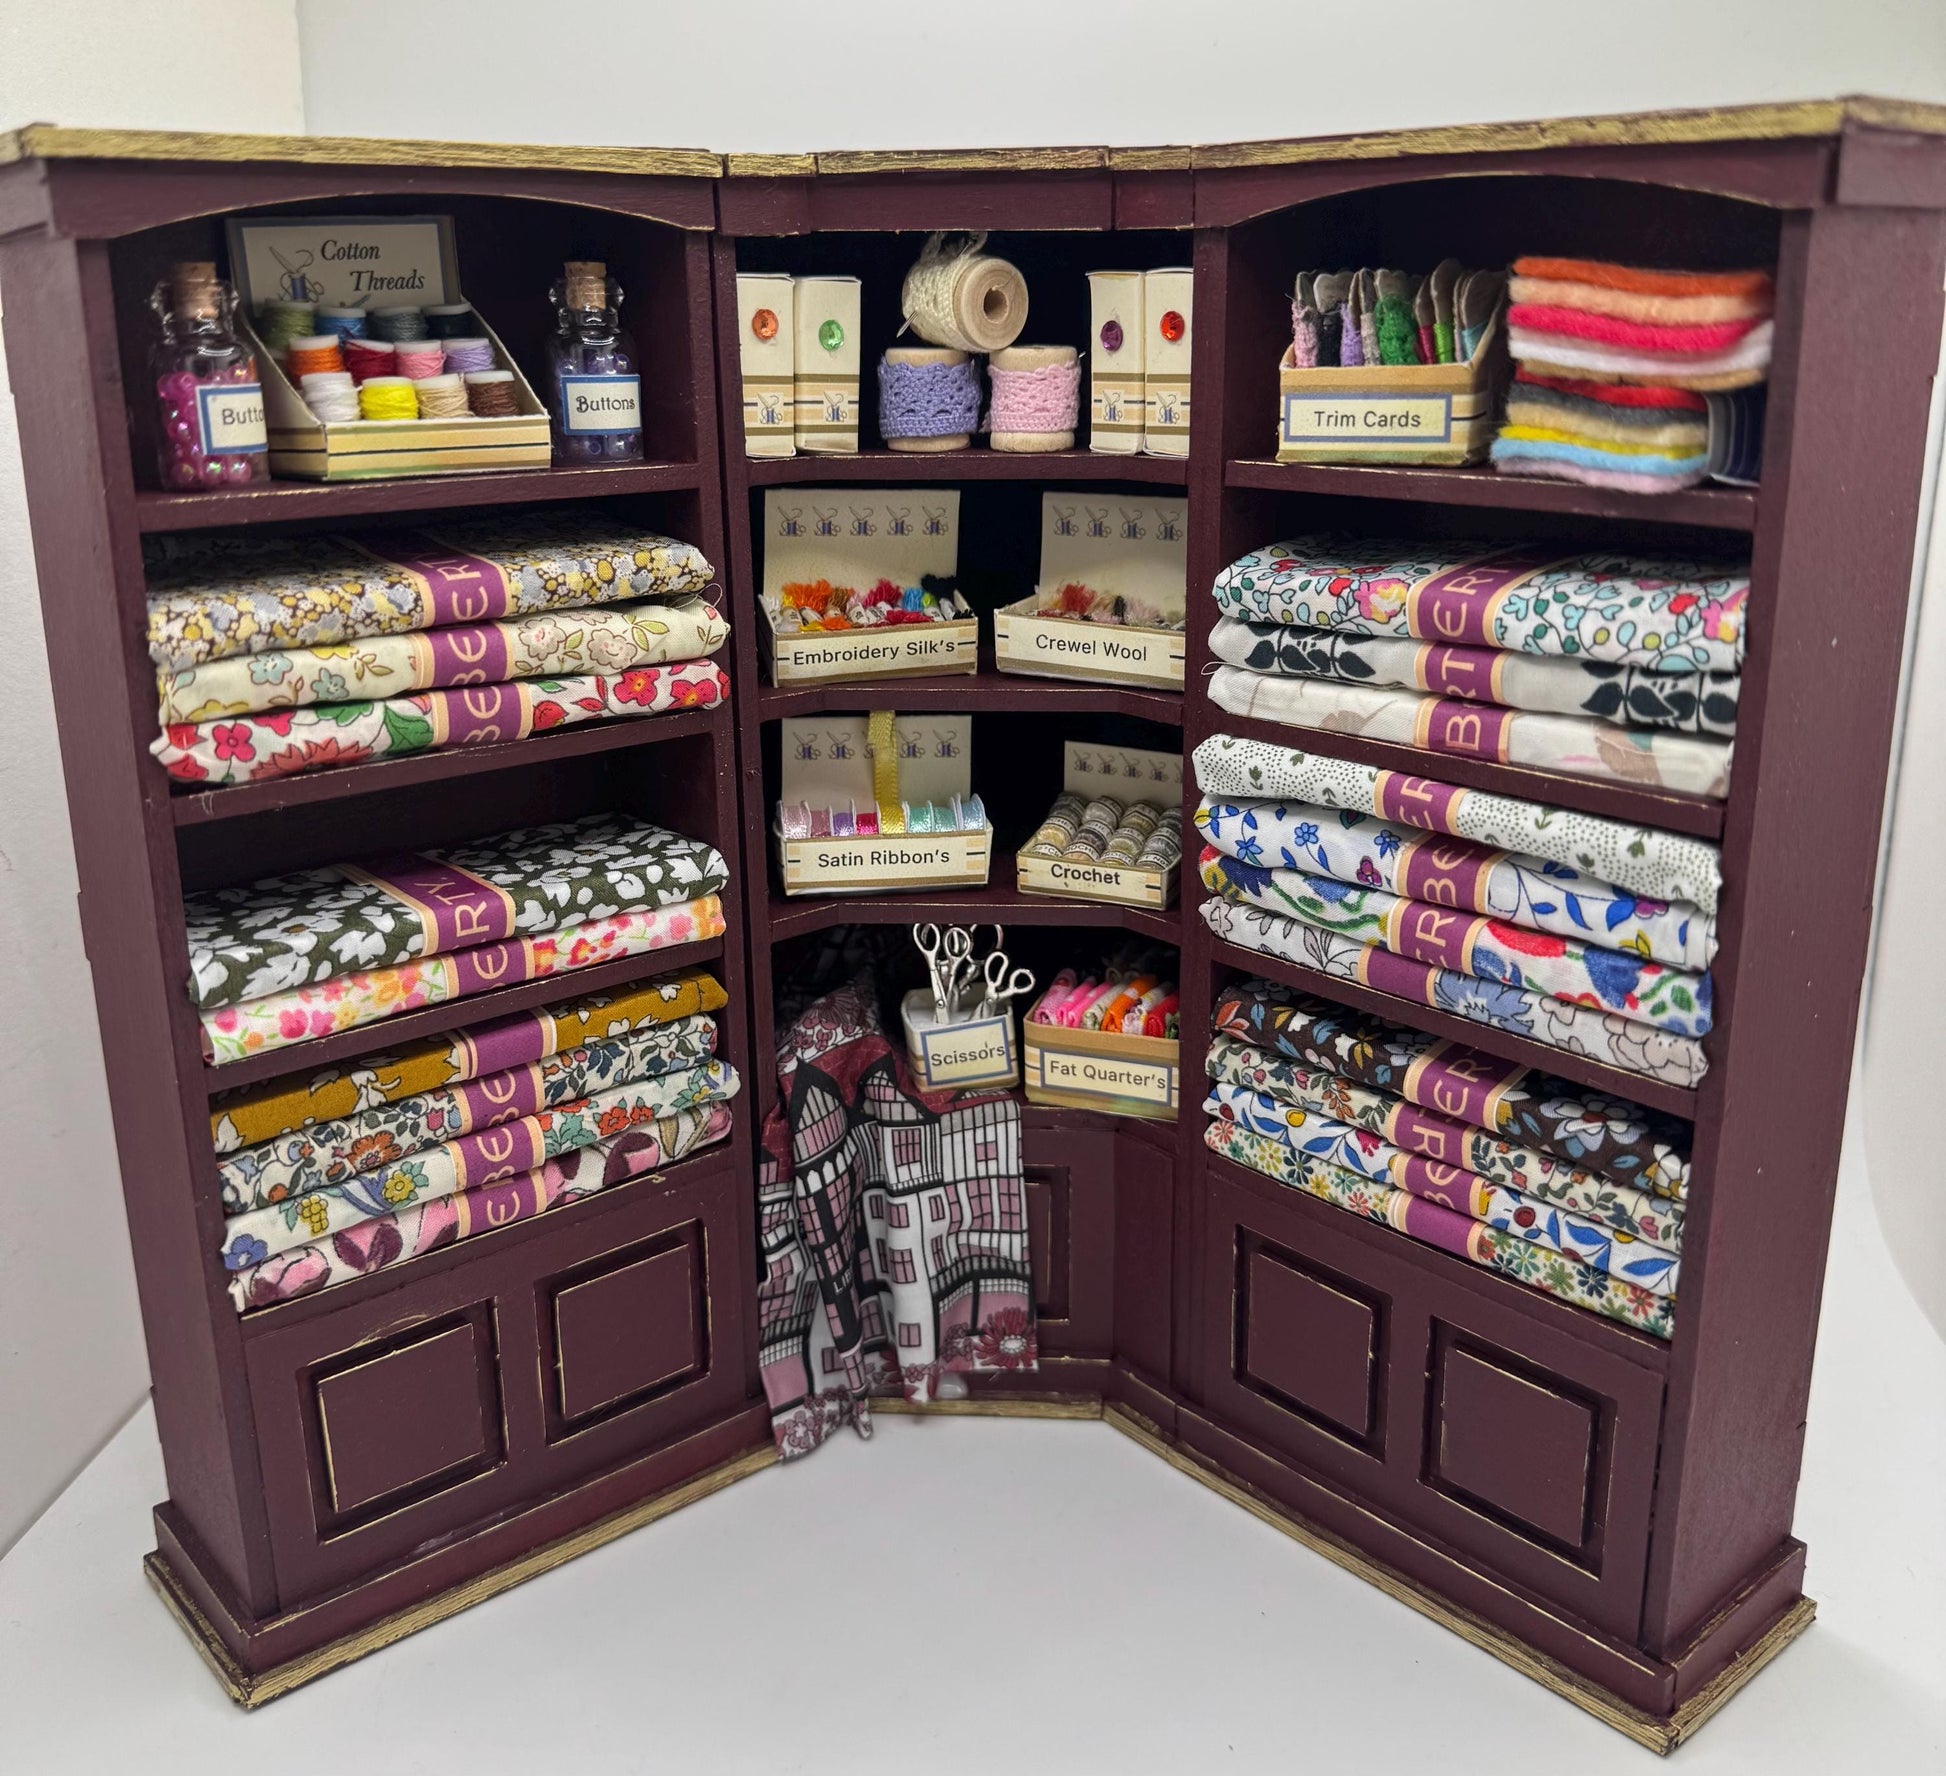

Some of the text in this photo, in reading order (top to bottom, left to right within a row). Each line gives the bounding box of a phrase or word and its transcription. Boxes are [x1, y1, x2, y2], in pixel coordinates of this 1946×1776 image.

[321, 239, 380, 261] Cotton
[349, 269, 425, 291] Threads
[576, 395, 635, 413] Buttons
[1314, 411, 1421, 427] Trim Cards
[794, 640, 955, 665] Embroidery Silk's
[1036, 634, 1147, 661] Crewel Wool
[818, 849, 950, 867] Satin Ribbon's
[1051, 863, 1121, 885] Crochet
[931, 1043, 1005, 1066] Scissors
[1050, 1060, 1166, 1089] Fat Quarter's
